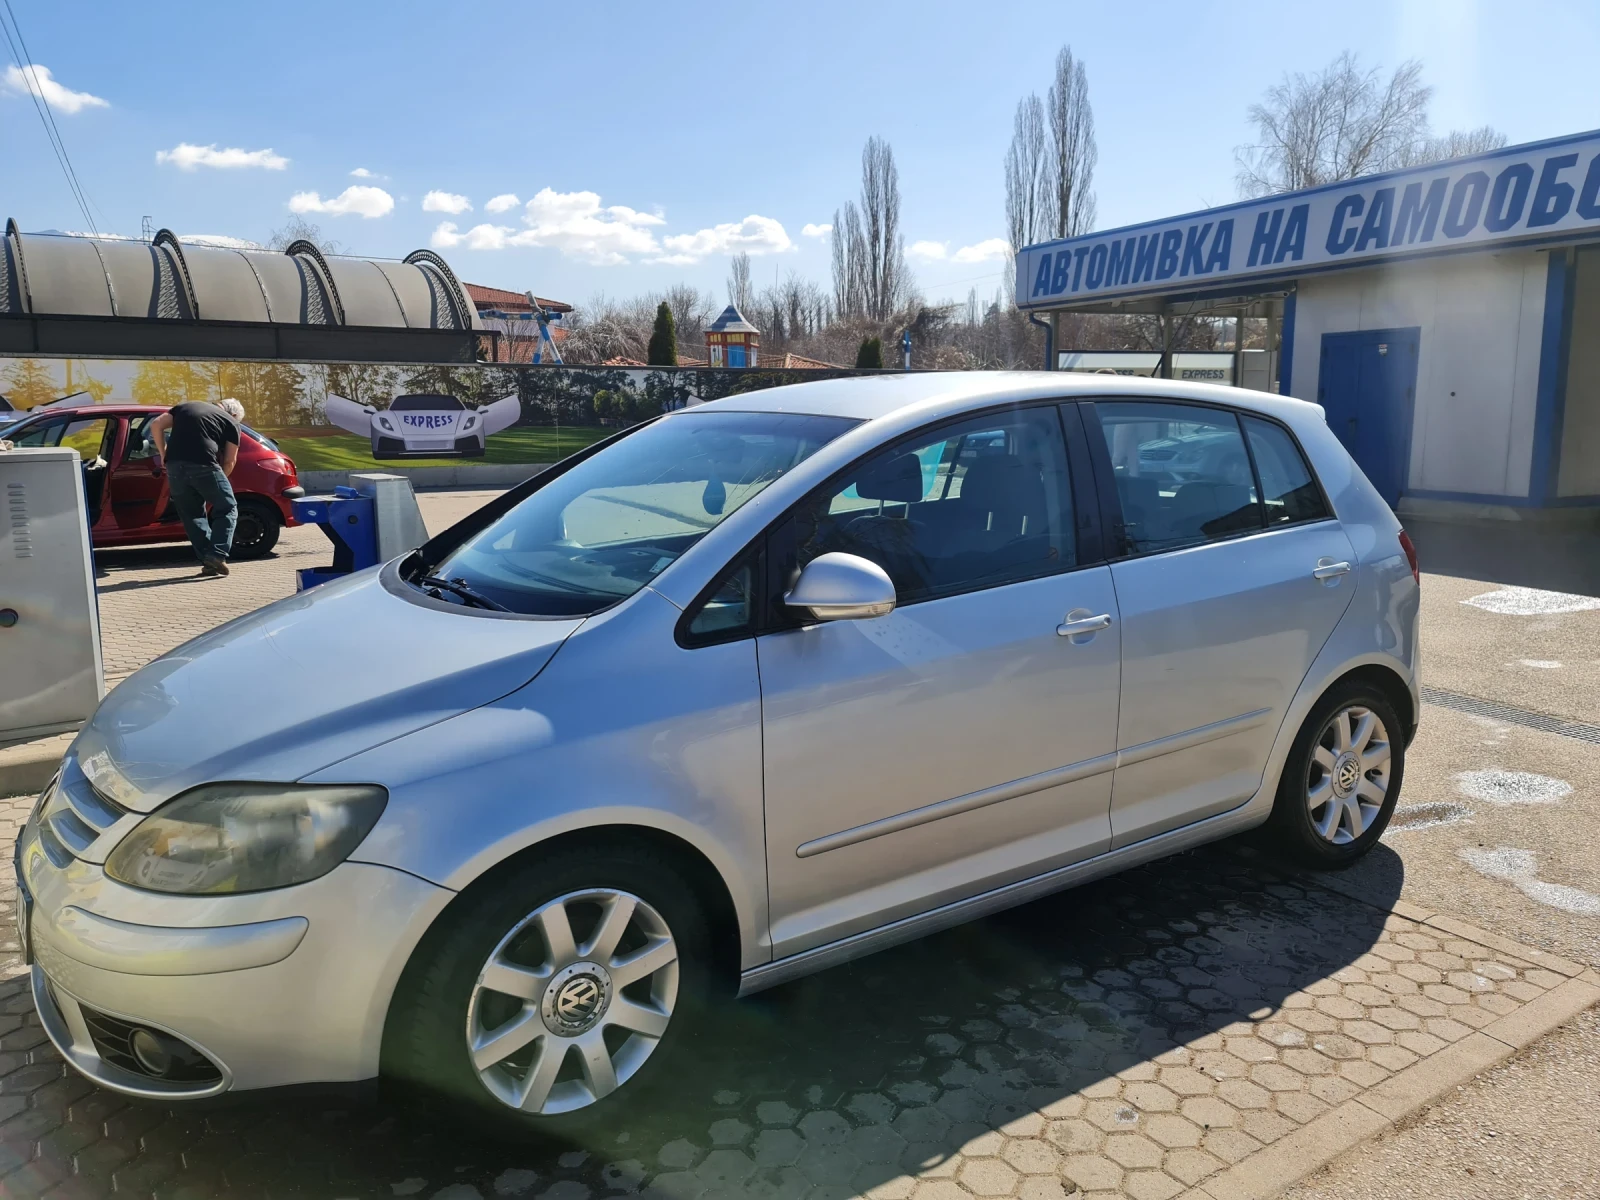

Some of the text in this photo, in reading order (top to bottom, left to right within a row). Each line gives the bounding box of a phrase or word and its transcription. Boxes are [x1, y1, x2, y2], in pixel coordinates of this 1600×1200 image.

[1032, 218, 1234, 297] АВТОМИВКА
[1246, 204, 1310, 267] НА
[1182, 369, 1225, 379] EXPRESS
[403, 415, 453, 429] EXPRESS
